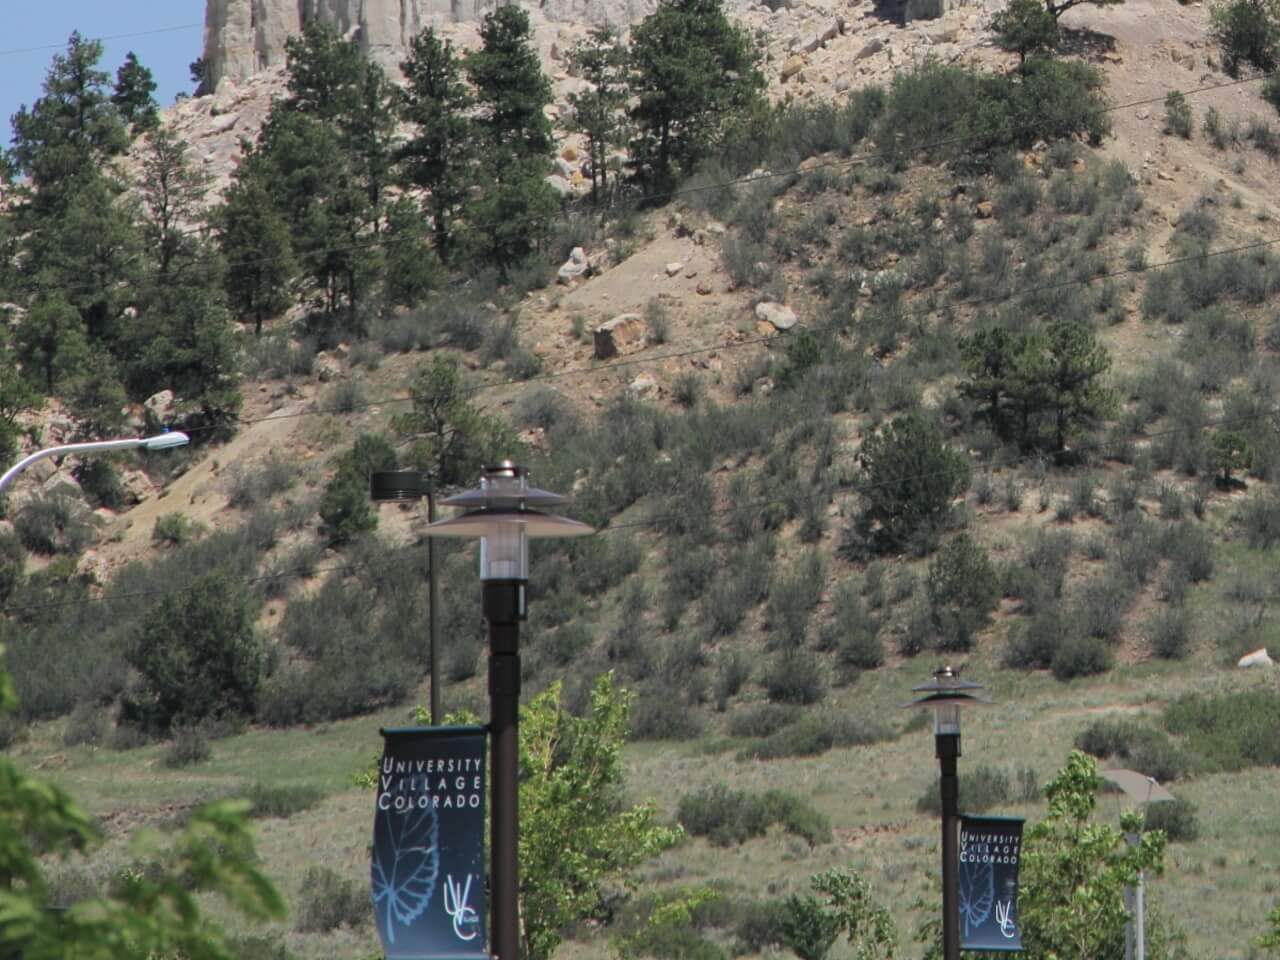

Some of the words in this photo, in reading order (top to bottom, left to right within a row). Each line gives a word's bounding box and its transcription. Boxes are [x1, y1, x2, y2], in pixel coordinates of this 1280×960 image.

[383, 756, 481, 774] UNIVERSITY
[381, 775, 481, 791] VILLAGE
[379, 792, 480, 810] COLORADO
[961, 831, 1019, 844] UNIVERSITY
[960, 841, 1018, 854] VILLAGE
[960, 851, 1017, 864] COLORADO
